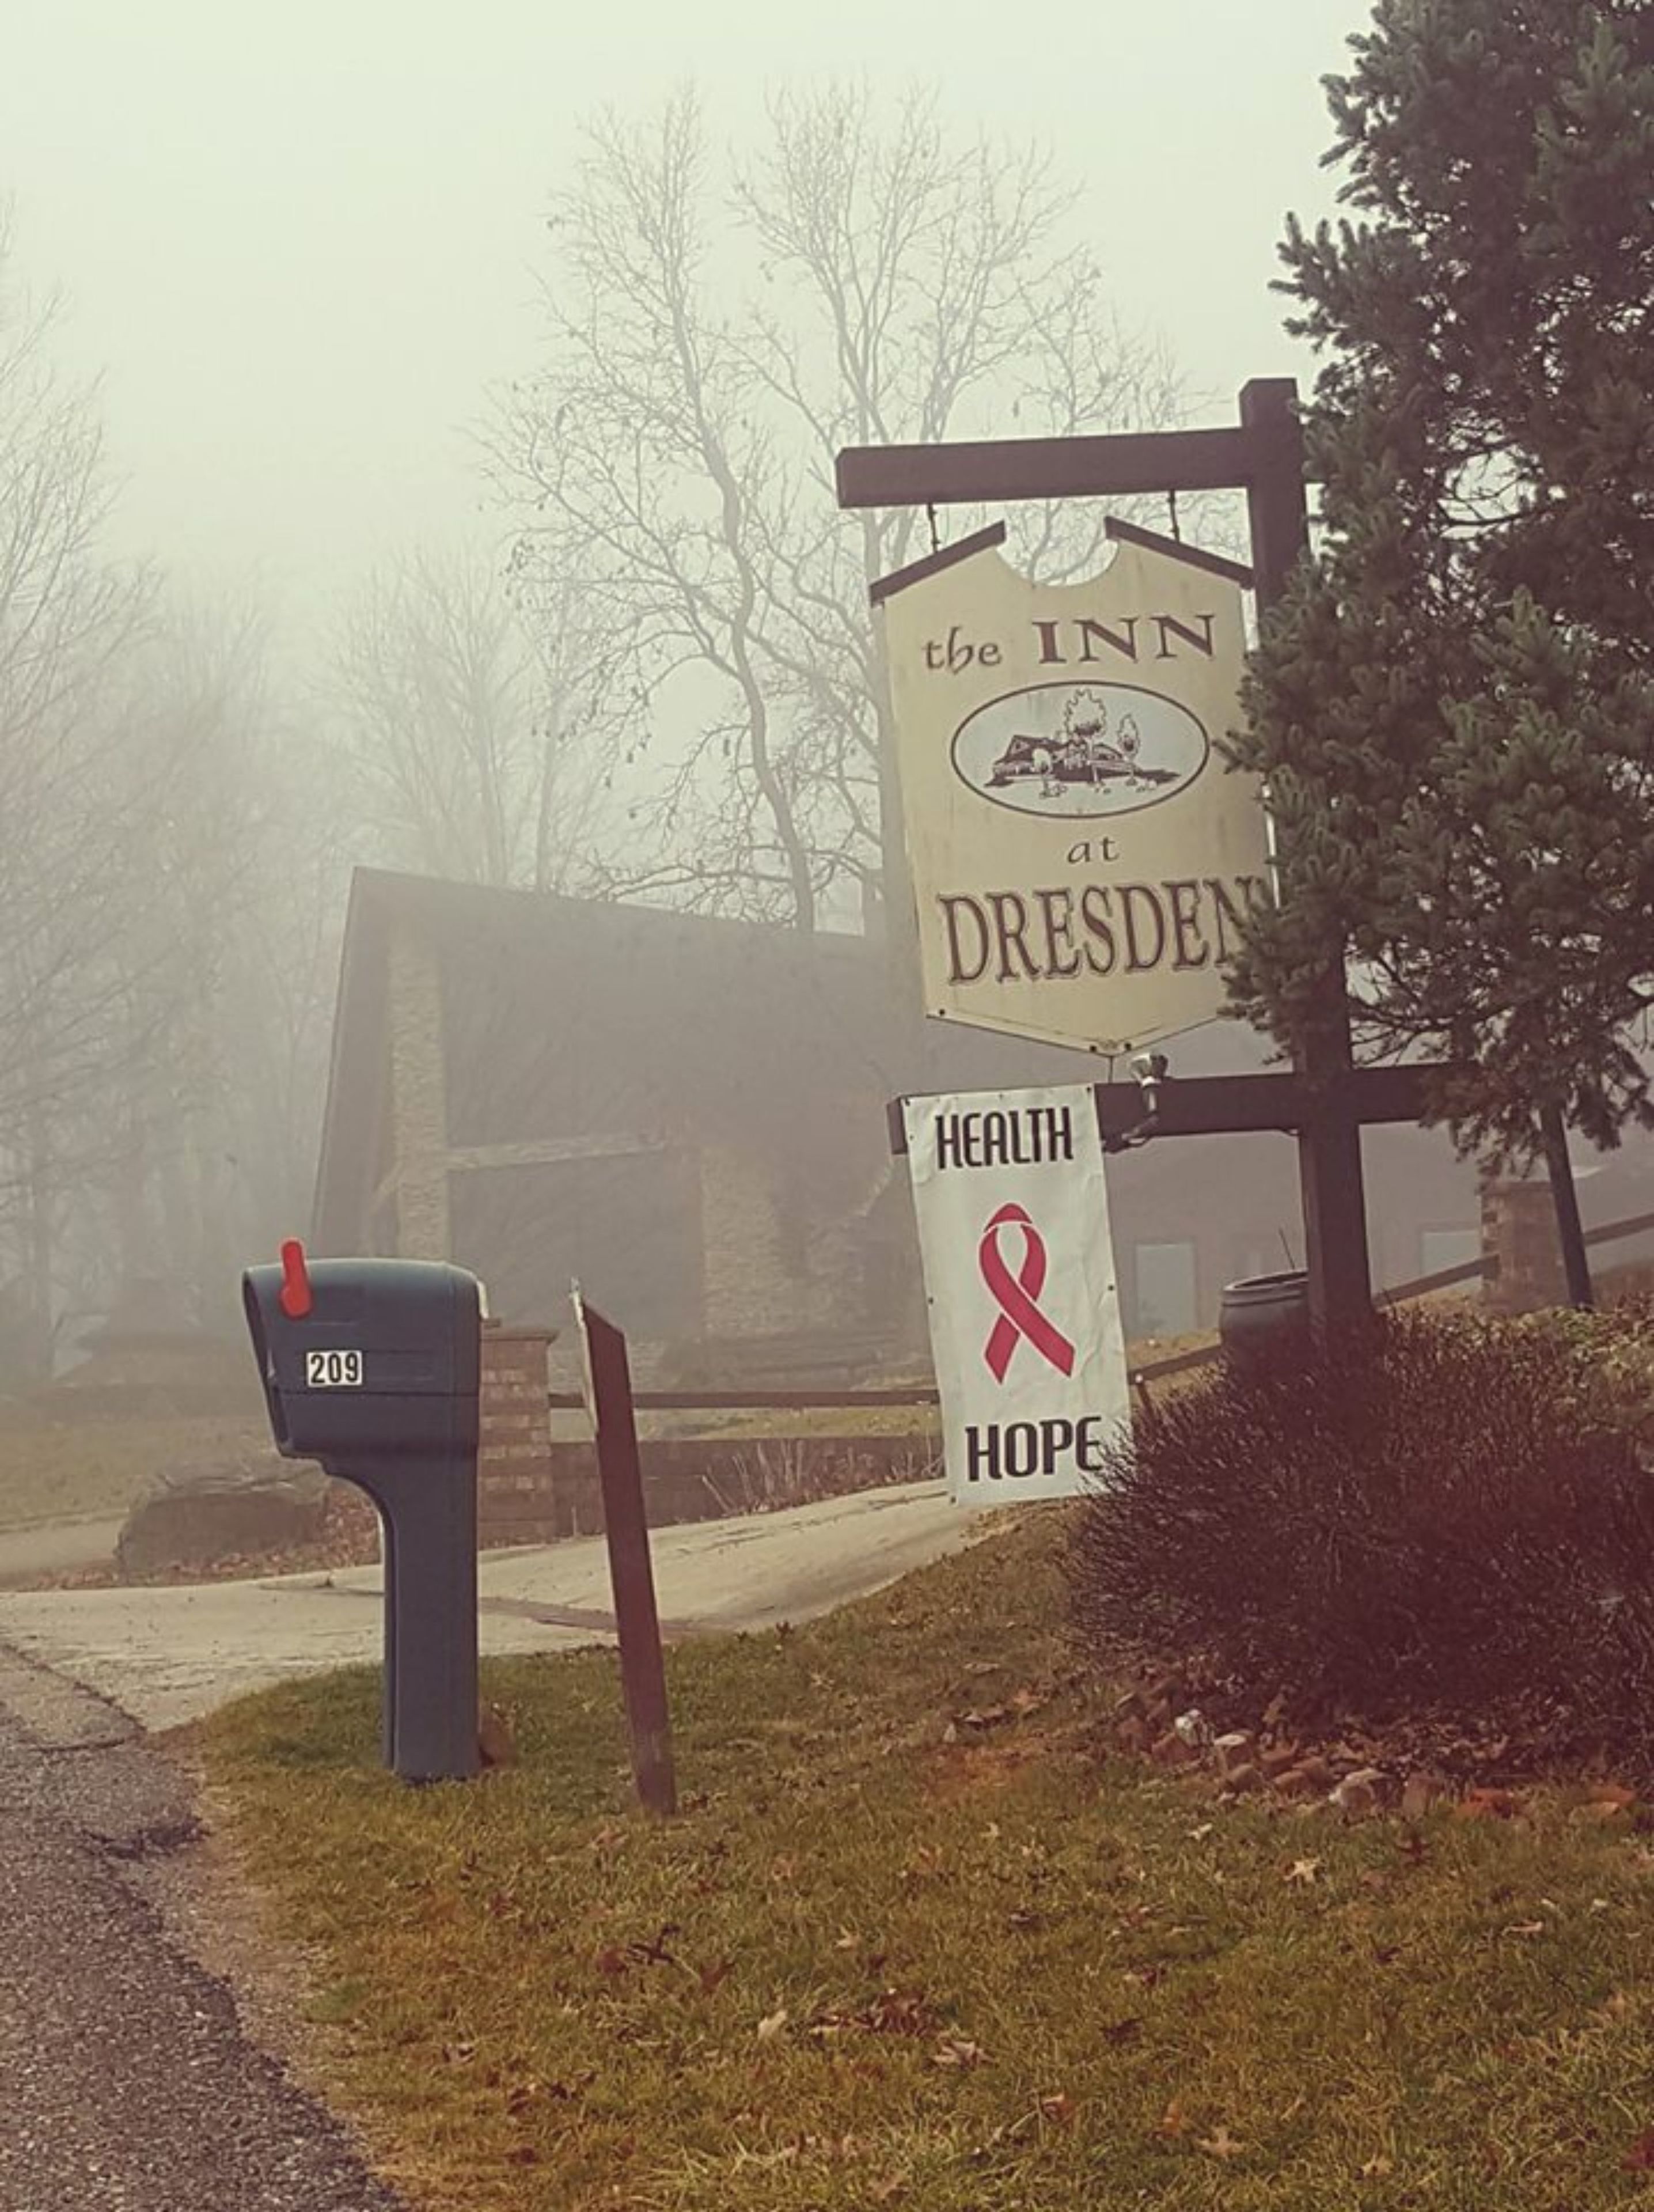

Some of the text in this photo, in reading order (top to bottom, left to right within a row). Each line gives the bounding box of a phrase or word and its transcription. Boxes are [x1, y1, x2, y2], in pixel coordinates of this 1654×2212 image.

[922, 614, 1215, 675] the INN
[1067, 836, 1120, 865] at
[937, 876, 1265, 985] DRESDEN
[934, 1106, 1073, 1169] HEALTH
[310, 1353, 358, 1383] 209
[965, 1416, 1103, 1482] HOPE
